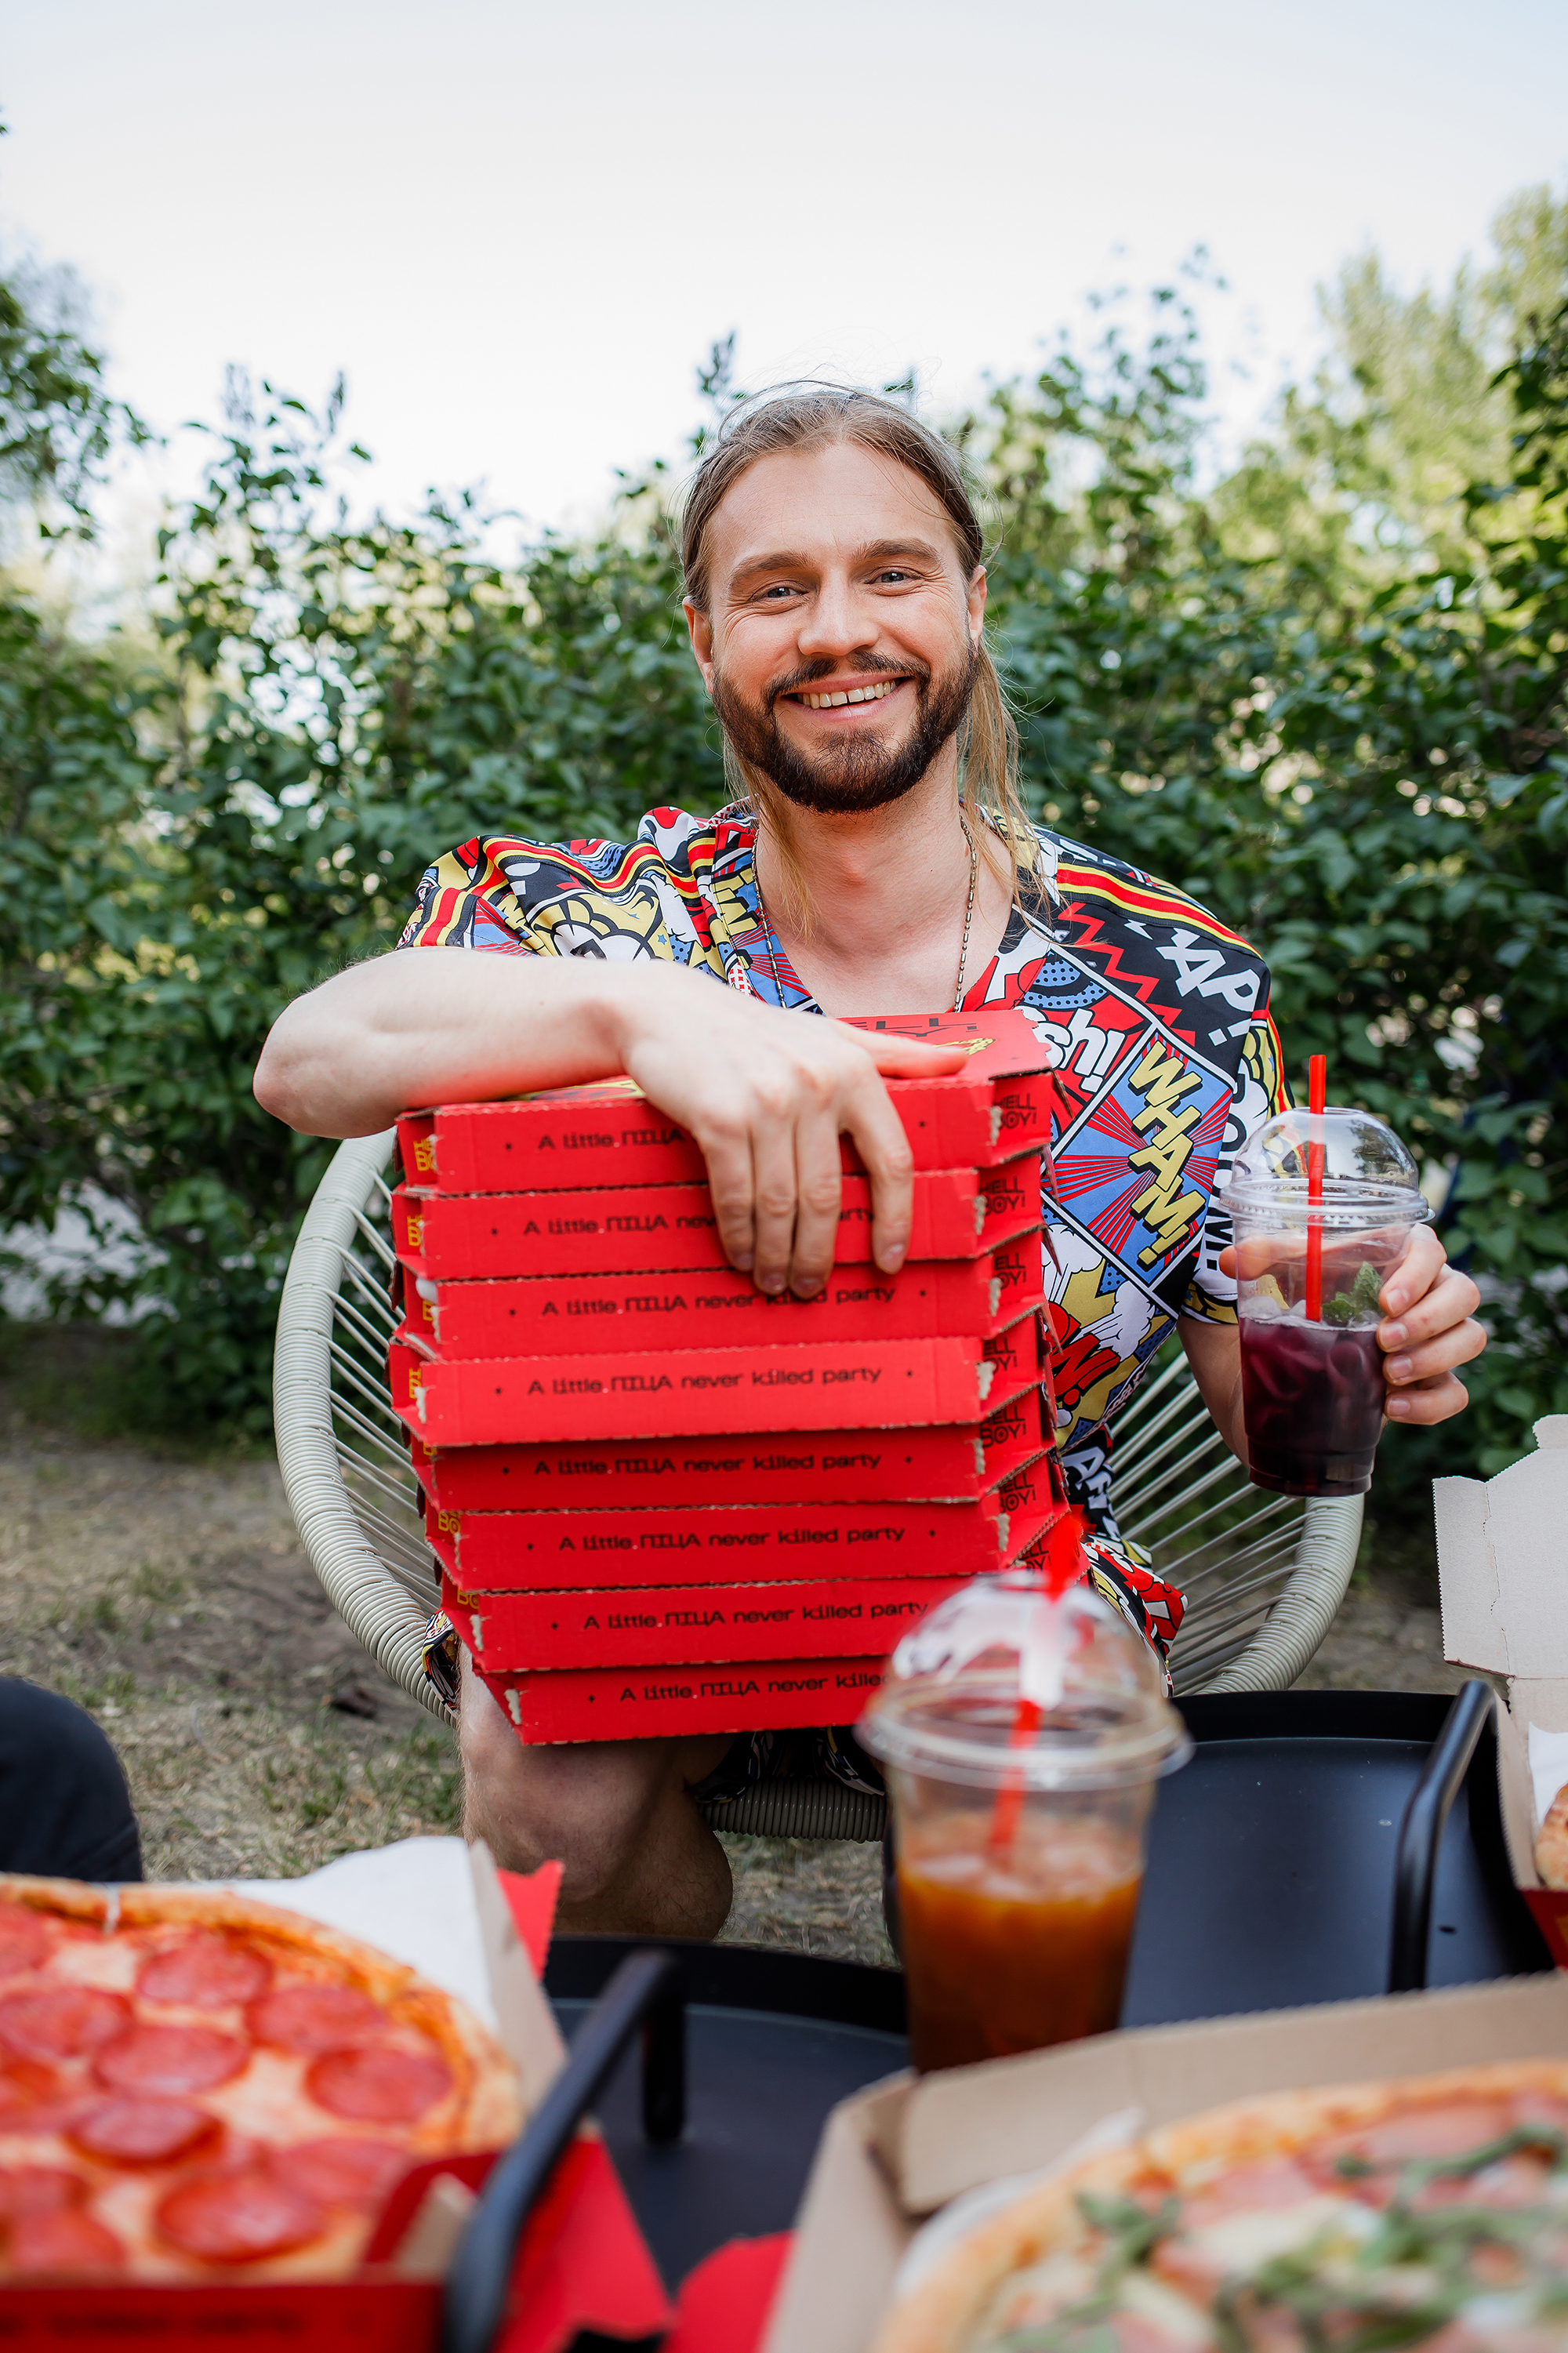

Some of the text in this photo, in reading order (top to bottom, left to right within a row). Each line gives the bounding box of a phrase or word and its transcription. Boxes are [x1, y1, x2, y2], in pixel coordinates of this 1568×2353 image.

[538, 1134, 556, 1150] A
[562, 1132, 614, 1149] little
[1127, 1040, 1207, 1267] WHAM!
[523, 1219, 541, 1236] A
[547, 1218, 598, 1235] little
[993, 1253, 1026, 1271] ELL
[996, 1270, 1027, 1290] OY!
[541, 1300, 559, 1316] A
[566, 1298, 617, 1315] little
[694, 1295, 755, 1309] never
[835, 1287, 897, 1305] party
[982, 1337, 1016, 1356] ELL
[528, 1380, 545, 1395] A
[552, 1378, 603, 1394] little
[681, 1373, 742, 1389] never
[751, 1369, 814, 1385] killed
[822, 1367, 882, 1385] party
[534, 1460, 551, 1476] A
[557, 1457, 608, 1475] little
[684, 1456, 746, 1472] never
[752, 1454, 815, 1470] killed
[822, 1452, 883, 1471] party
[999, 1472, 1035, 1494] ELL
[557, 1535, 577, 1552] A
[582, 1534, 633, 1551] little
[708, 1531, 771, 1547] never
[777, 1527, 840, 1544] killed
[846, 1526, 906, 1545] party
[583, 1614, 601, 1630] A
[607, 1612, 657, 1629] little
[732, 1607, 795, 1624] never
[801, 1602, 862, 1621] killed
[869, 1600, 929, 1621] party
[619, 1687, 637, 1702] A
[643, 1683, 693, 1701] little
[768, 1676, 829, 1693] never
